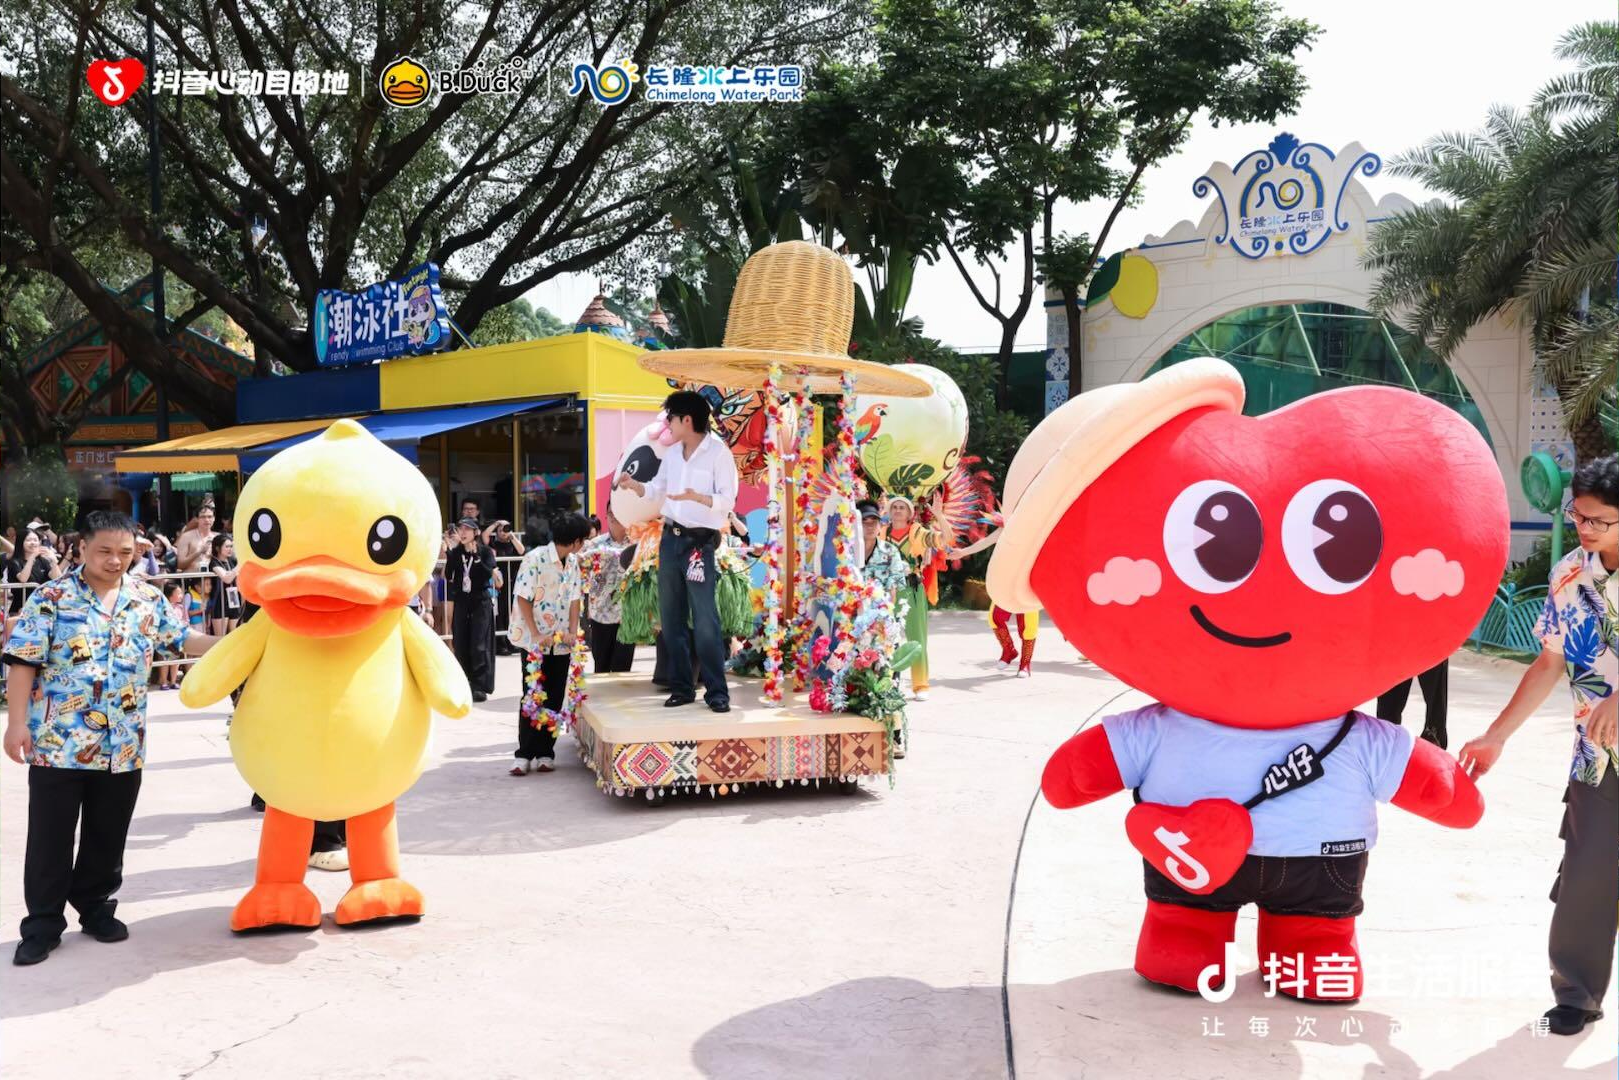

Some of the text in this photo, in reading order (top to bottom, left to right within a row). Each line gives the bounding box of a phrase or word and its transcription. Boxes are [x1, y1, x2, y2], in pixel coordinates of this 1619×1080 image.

[328, 285, 410, 349] 潮泳社
[386, 340, 405, 352] Club
[1264, 744, 1313, 794] 心仔
